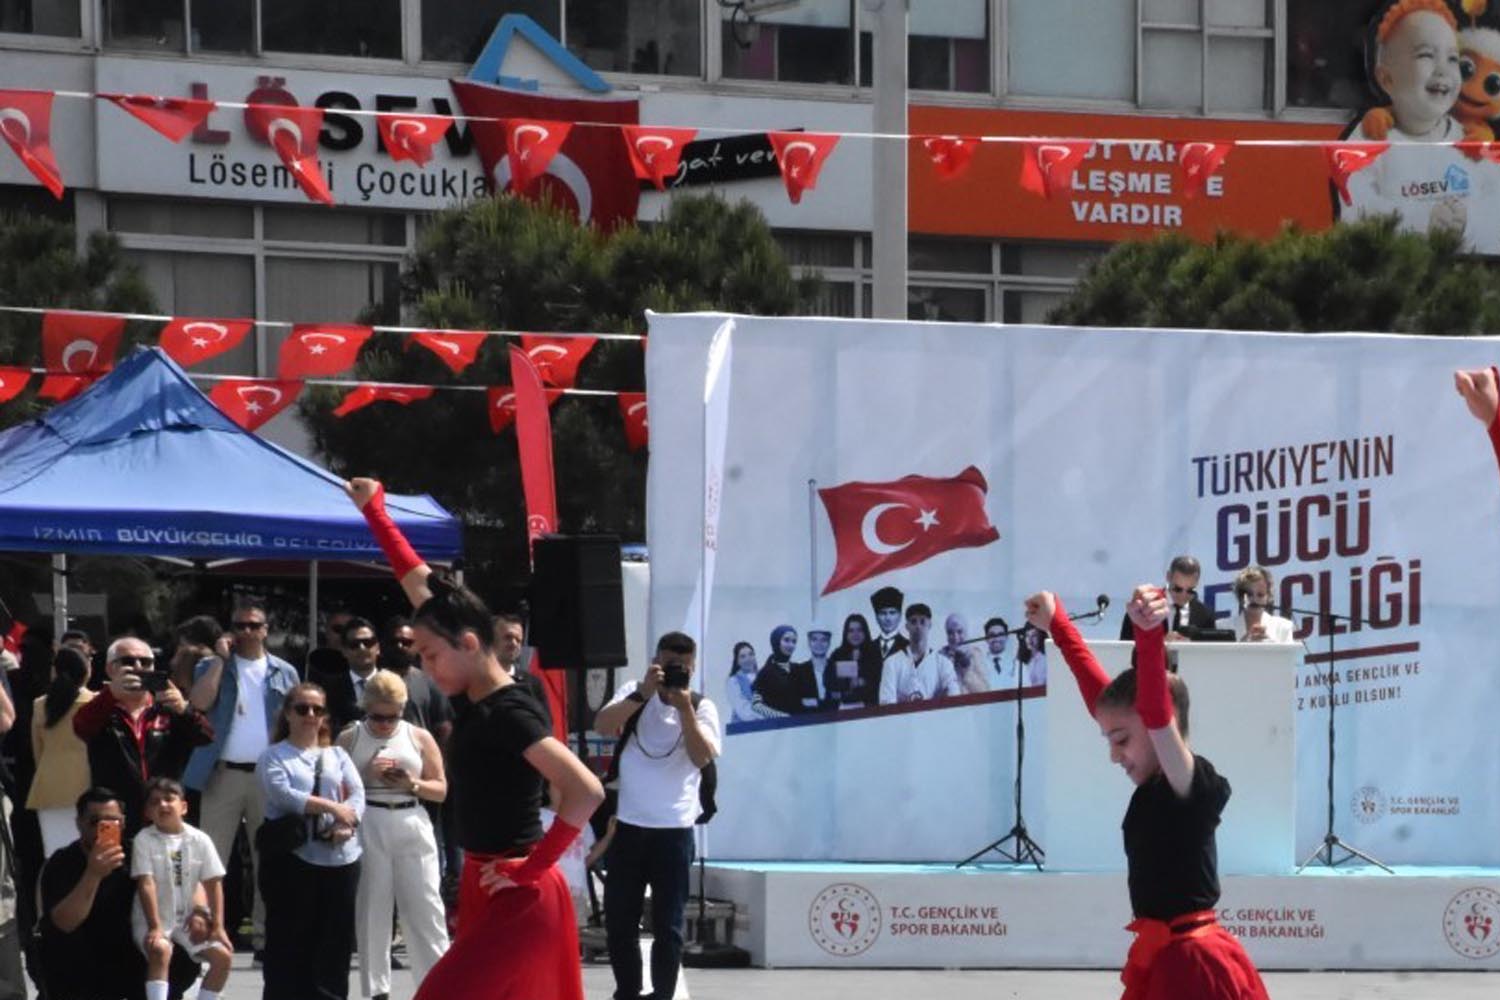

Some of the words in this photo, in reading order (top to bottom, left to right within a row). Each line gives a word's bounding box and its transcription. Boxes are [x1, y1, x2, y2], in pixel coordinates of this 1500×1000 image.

[188, 153, 334, 192] Lösemi
[356, 162, 488, 201] Çocukla
[1071, 169, 1172, 197] LEŞME
[1401, 181, 1449, 197] LÖSEV
[1071, 201, 1183, 226] VARDIR
[1192, 434, 1394, 498] TÜRKİYE'NİN
[1216, 489, 1371, 572] GÜCÜ
[1405, 661, 1420, 675] VE
[1310, 693, 1350, 709] KULU
[1355, 686, 1402, 703] OLSUN!
[890, 906, 915, 919] T.C.
[918, 904, 977, 922] GENÇLİK
[982, 906, 999, 919] VE
[1236, 906, 1295, 924] GENÇLİK
[1298, 908, 1316, 921] VE
[890, 923, 930, 936] SPOR
[931, 922, 1007, 937] BAKANLIĞI
[1249, 923, 1325, 939] BAKANLIĞI
